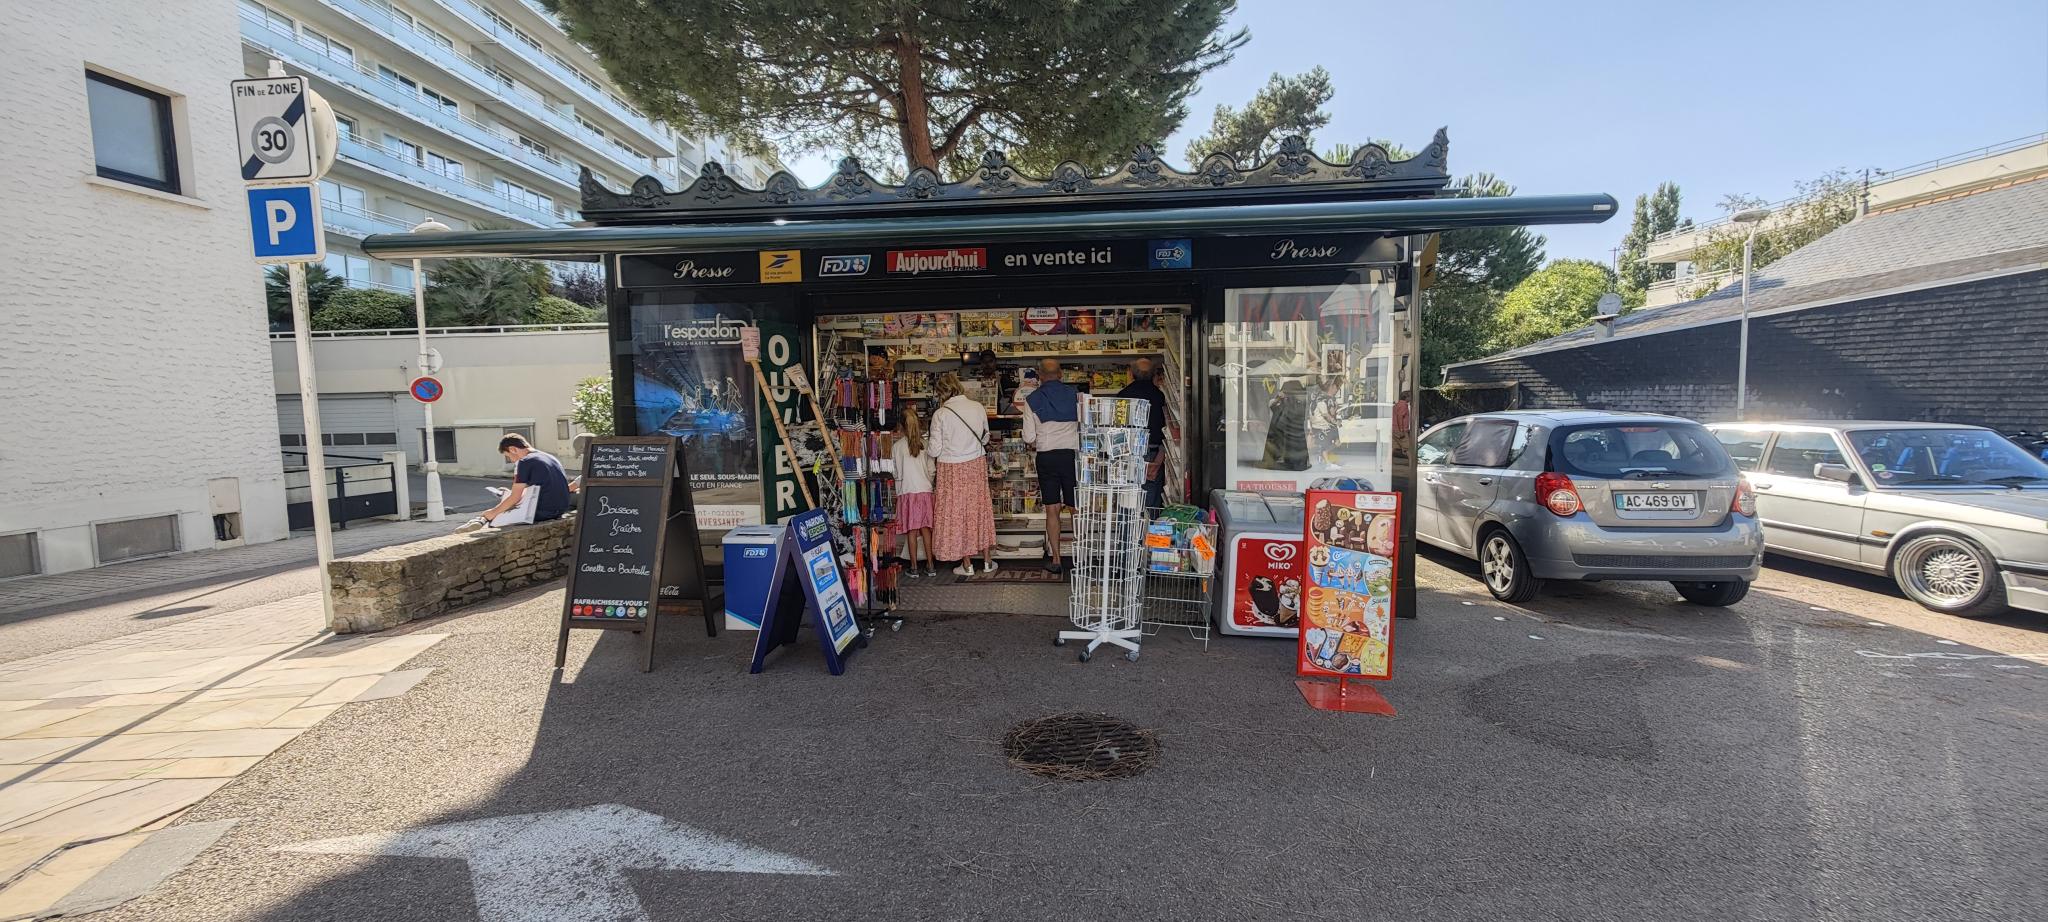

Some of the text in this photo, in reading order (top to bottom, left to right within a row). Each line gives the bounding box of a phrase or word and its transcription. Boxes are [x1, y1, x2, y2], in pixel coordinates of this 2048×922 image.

[236, 85, 255, 97] FIN
[267, 83, 298, 95] ZONE
[259, 129, 287, 151] 30
[265, 200, 296, 246] P
[1004, 246, 1112, 266] en vente ici
[1271, 238, 1340, 260] Presse
[673, 259, 736, 280] Presse
[824, 260, 851, 272] FDJ
[896, 250, 978, 275] Aujourd'hui
[664, 313, 740, 340] l'espadon
[718, 473, 760, 481] SOUS-MARIN
[717, 481, 743, 489] FRANCE
[1253, 483, 1294, 491] TROUSSE
[596, 496, 640, 516] Boissons
[809, 524, 826, 537] SPORT
[613, 545, 634, 555] Soda
[618, 562, 651, 576] Bouteille
[1268, 562, 1291, 570] MIKO
